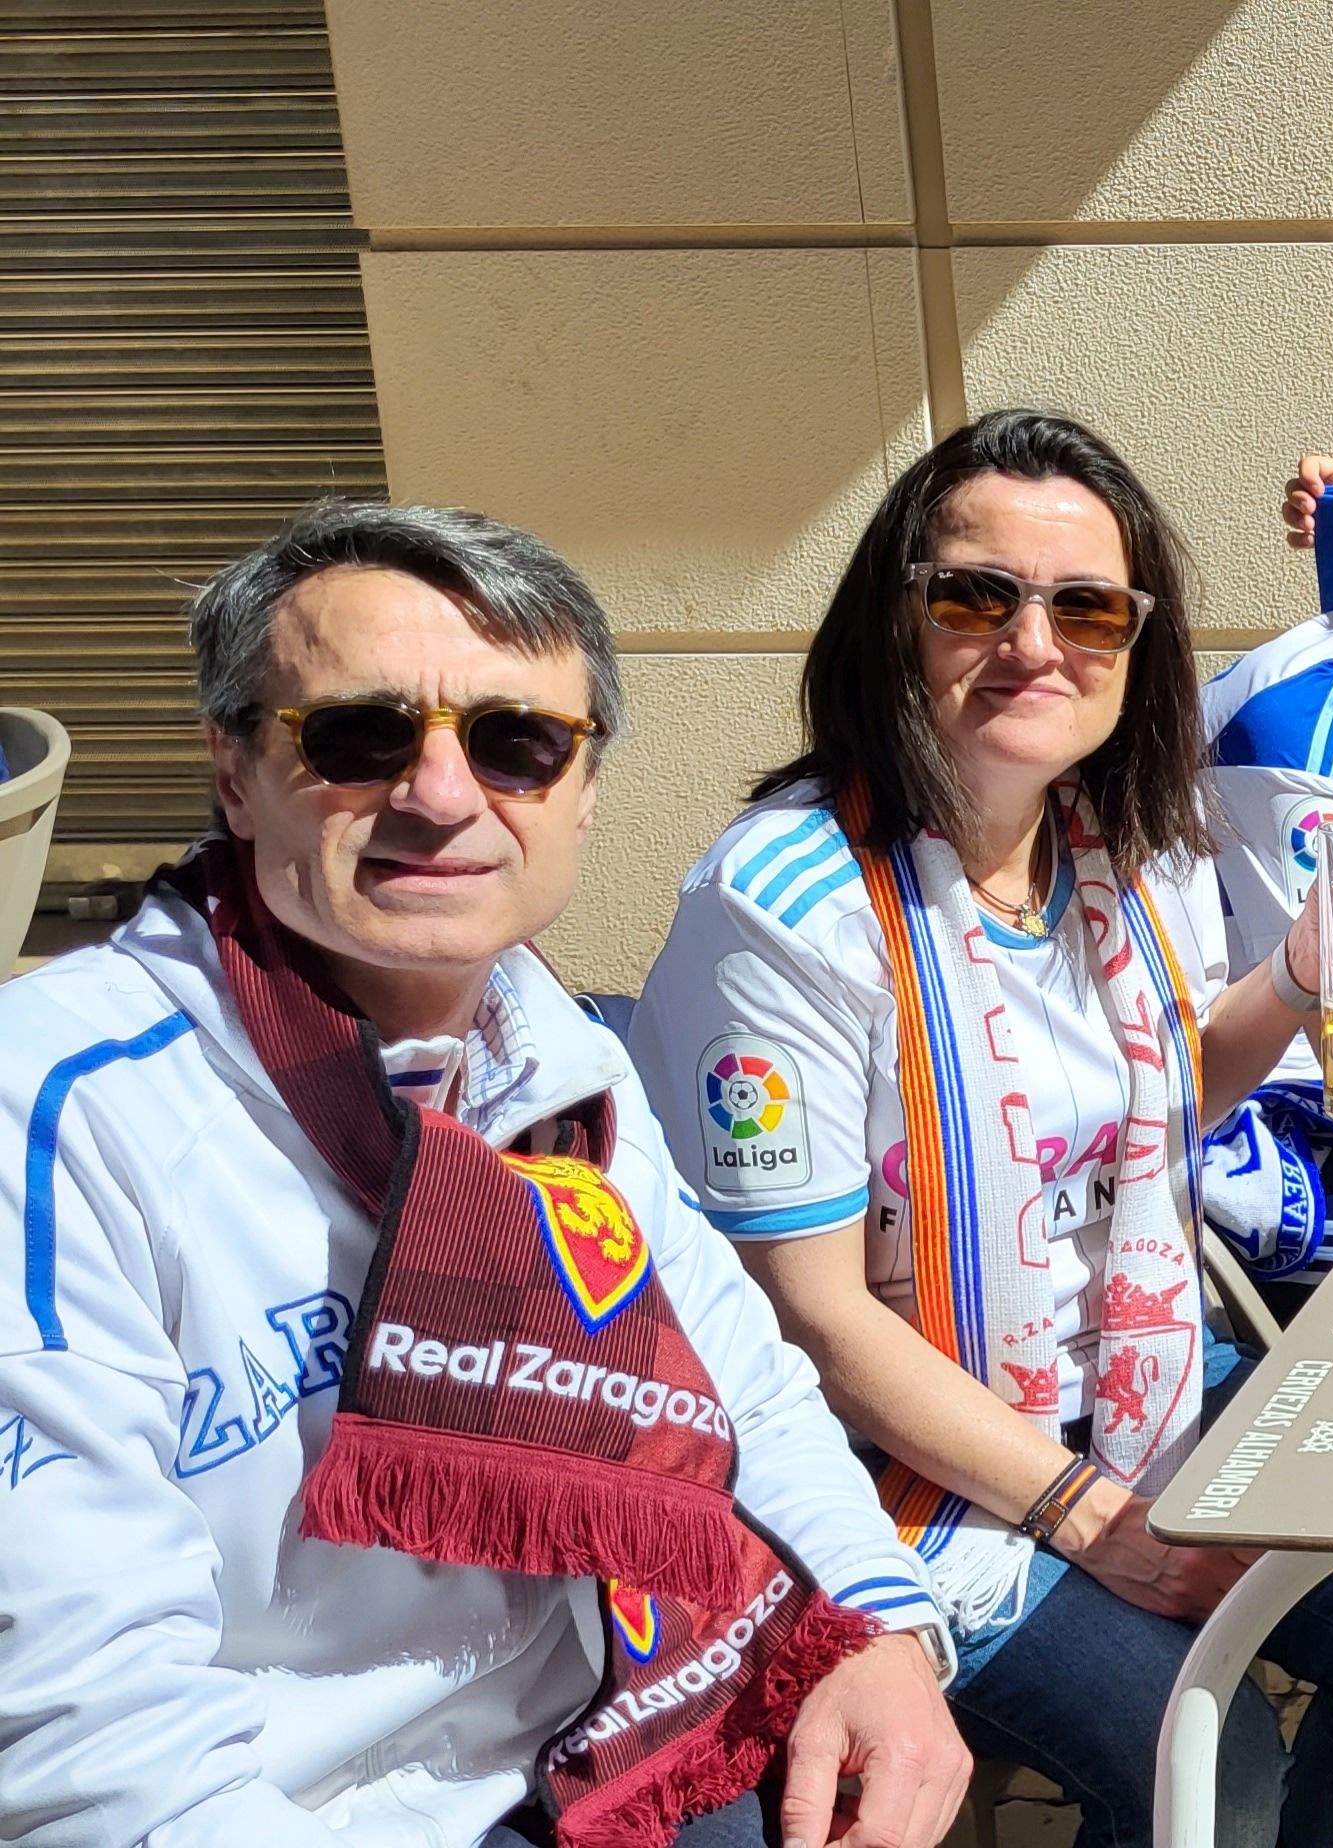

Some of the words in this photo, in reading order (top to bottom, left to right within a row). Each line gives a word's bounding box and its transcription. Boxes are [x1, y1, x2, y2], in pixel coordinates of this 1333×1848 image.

[712, 1144, 798, 1171] LaLiga
[368, 1321, 506, 1386] Real
[506, 1343, 731, 1442] Zaragoza
[1253, 1360, 1333, 1428] CERVEZAS
[1185, 1430, 1284, 1519] ALHAMBRA
[613, 1568, 795, 1722] Zaragoza
